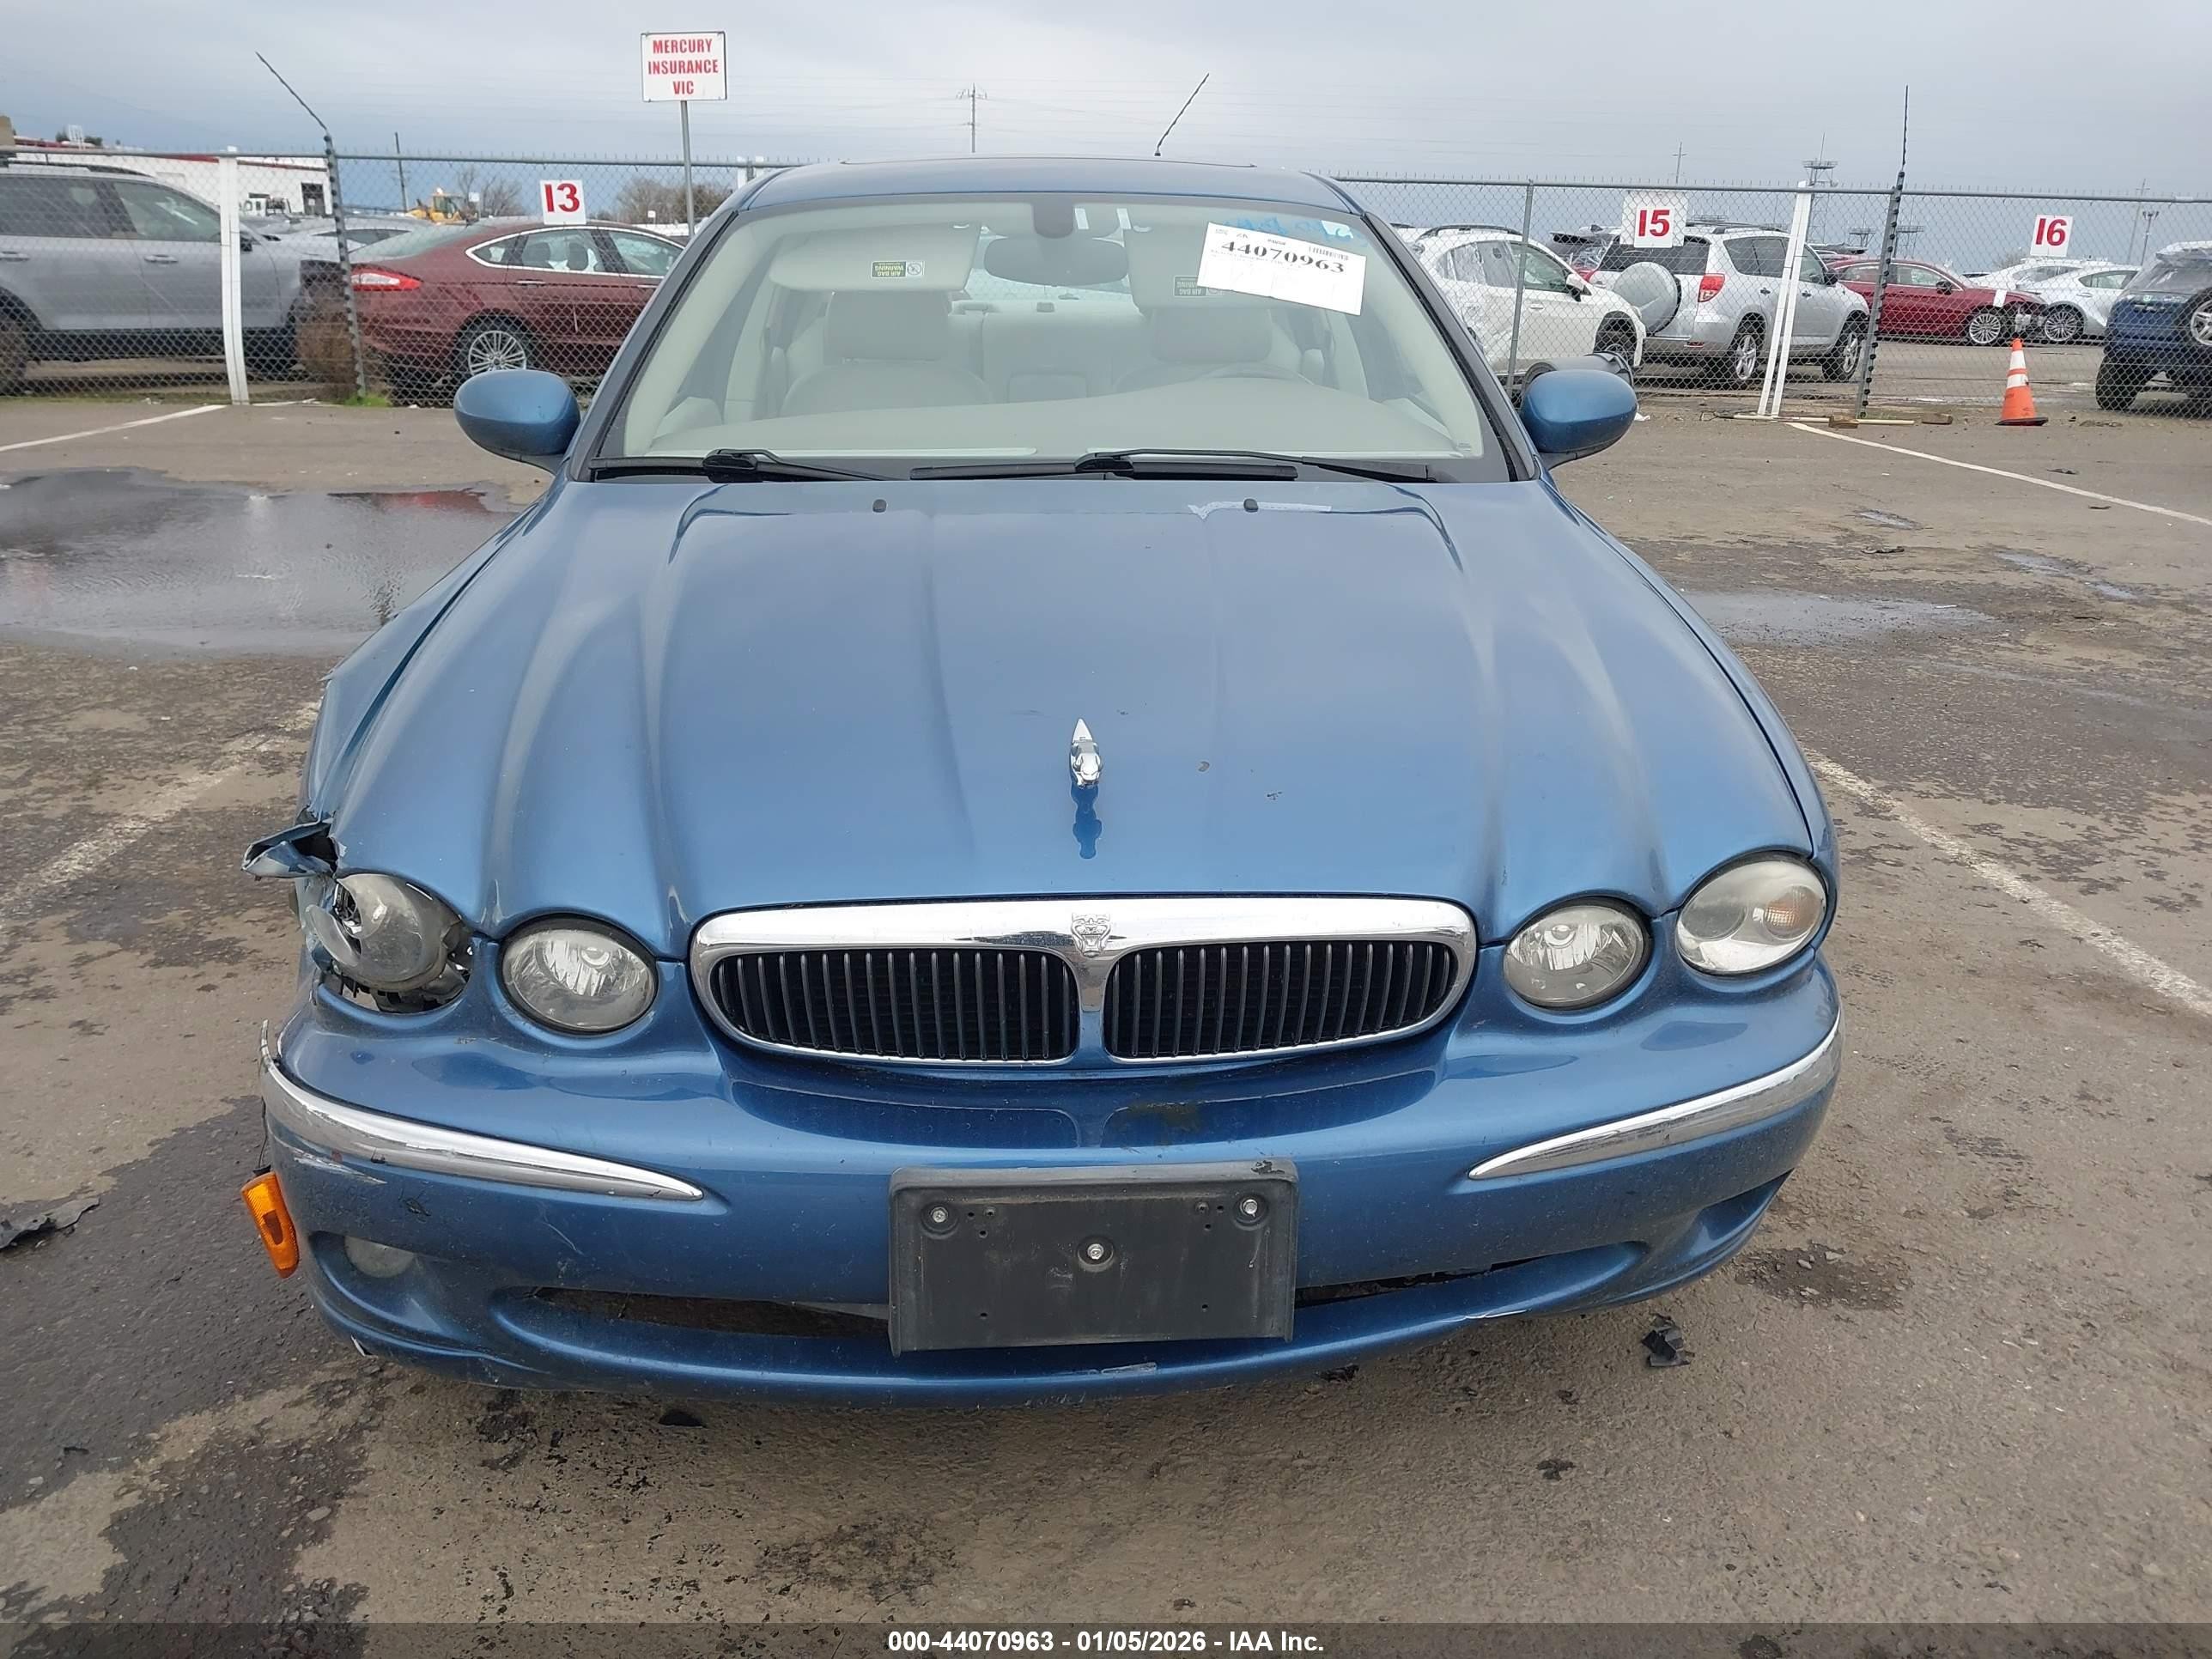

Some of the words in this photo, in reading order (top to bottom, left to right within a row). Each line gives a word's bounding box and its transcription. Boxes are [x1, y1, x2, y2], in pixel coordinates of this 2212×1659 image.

[653, 38, 713, 53] MERCURY
[647, 58, 719, 75] INSURANCE
[672, 80, 694, 94] VIC
[544, 183, 580, 212] 13
[1638, 210, 1670, 237] 15
[2035, 218, 2067, 246] 16
[1221, 240, 1345, 273] 44070963
